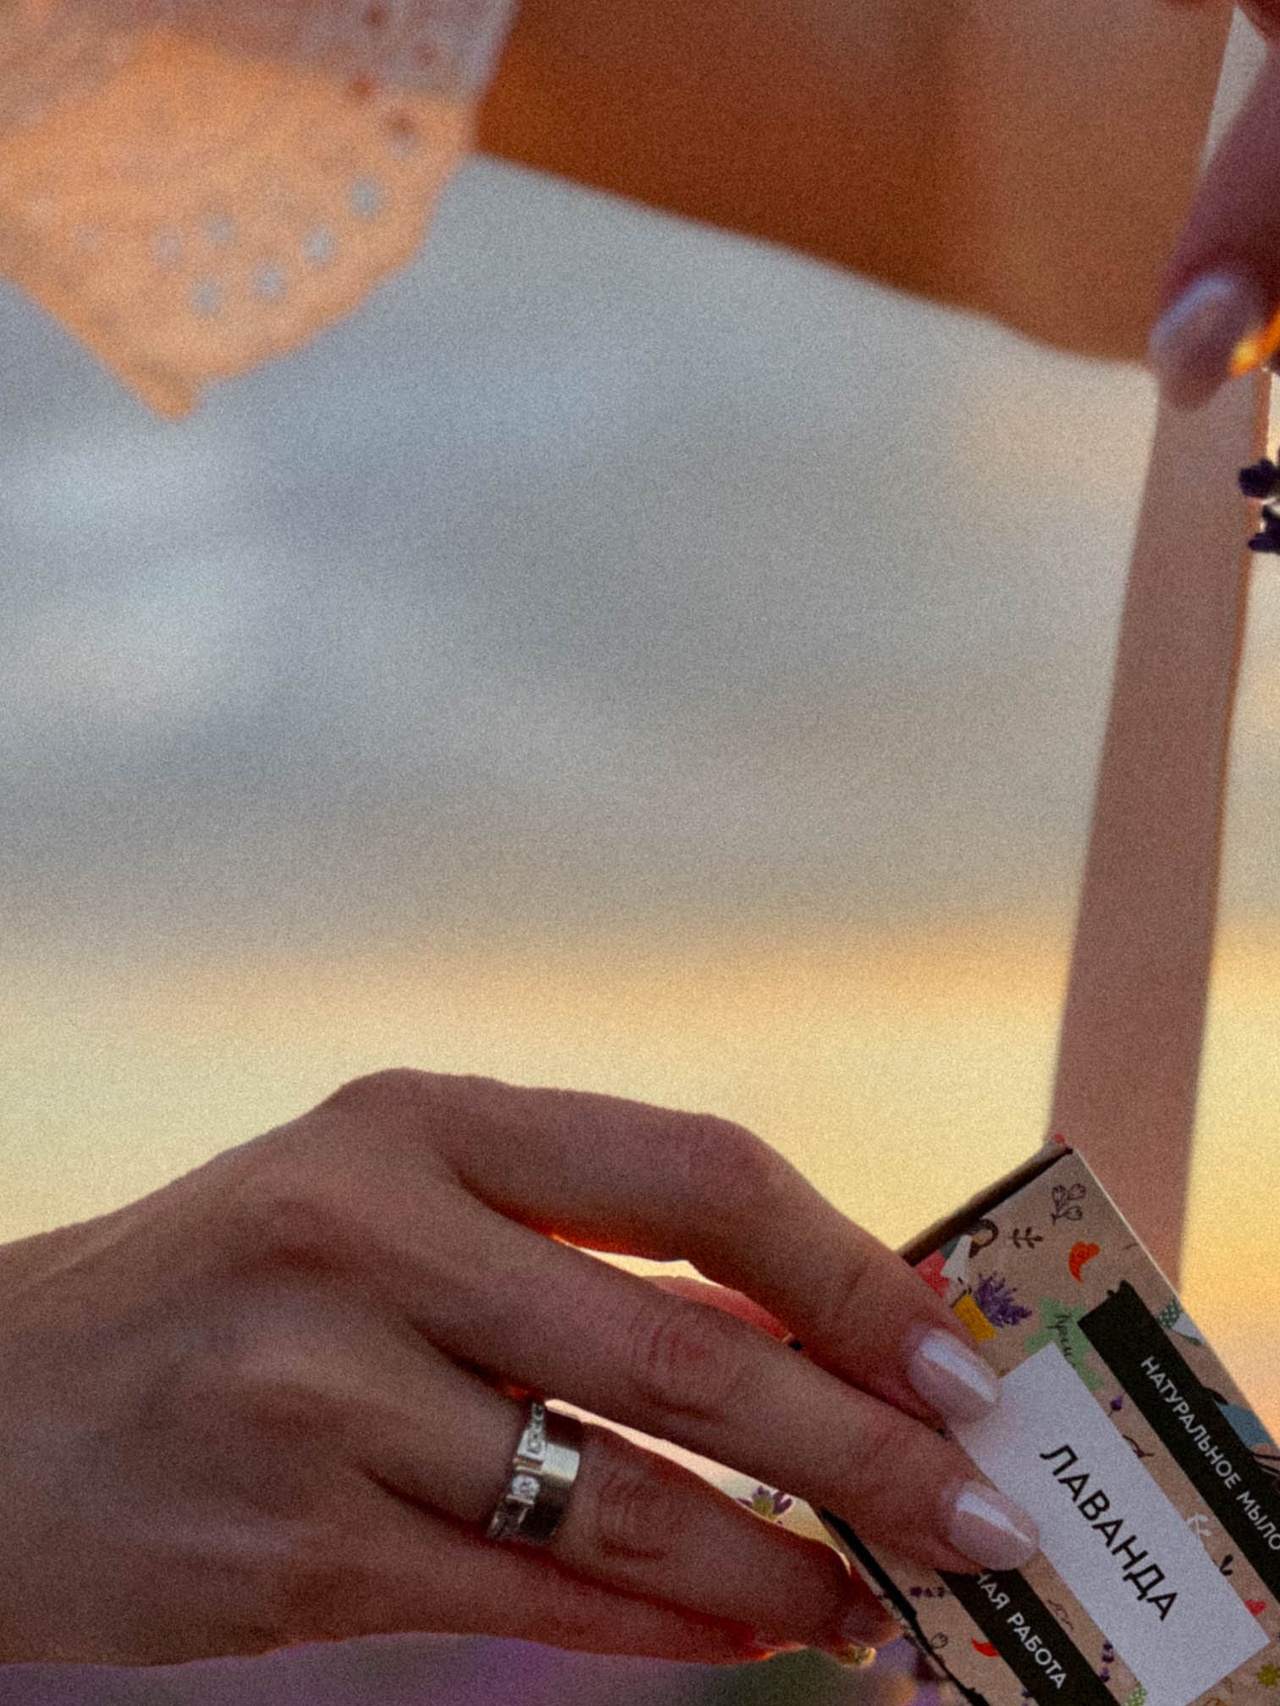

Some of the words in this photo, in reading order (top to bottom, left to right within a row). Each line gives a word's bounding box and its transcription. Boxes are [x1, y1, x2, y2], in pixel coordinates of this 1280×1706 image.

[1141, 1356, 1241, 1489] НАТУРАЛЬНОЕ
[1039, 1444, 1179, 1622] ЛАВАНДА
[1006, 1611, 1067, 1690] РАБОТА
